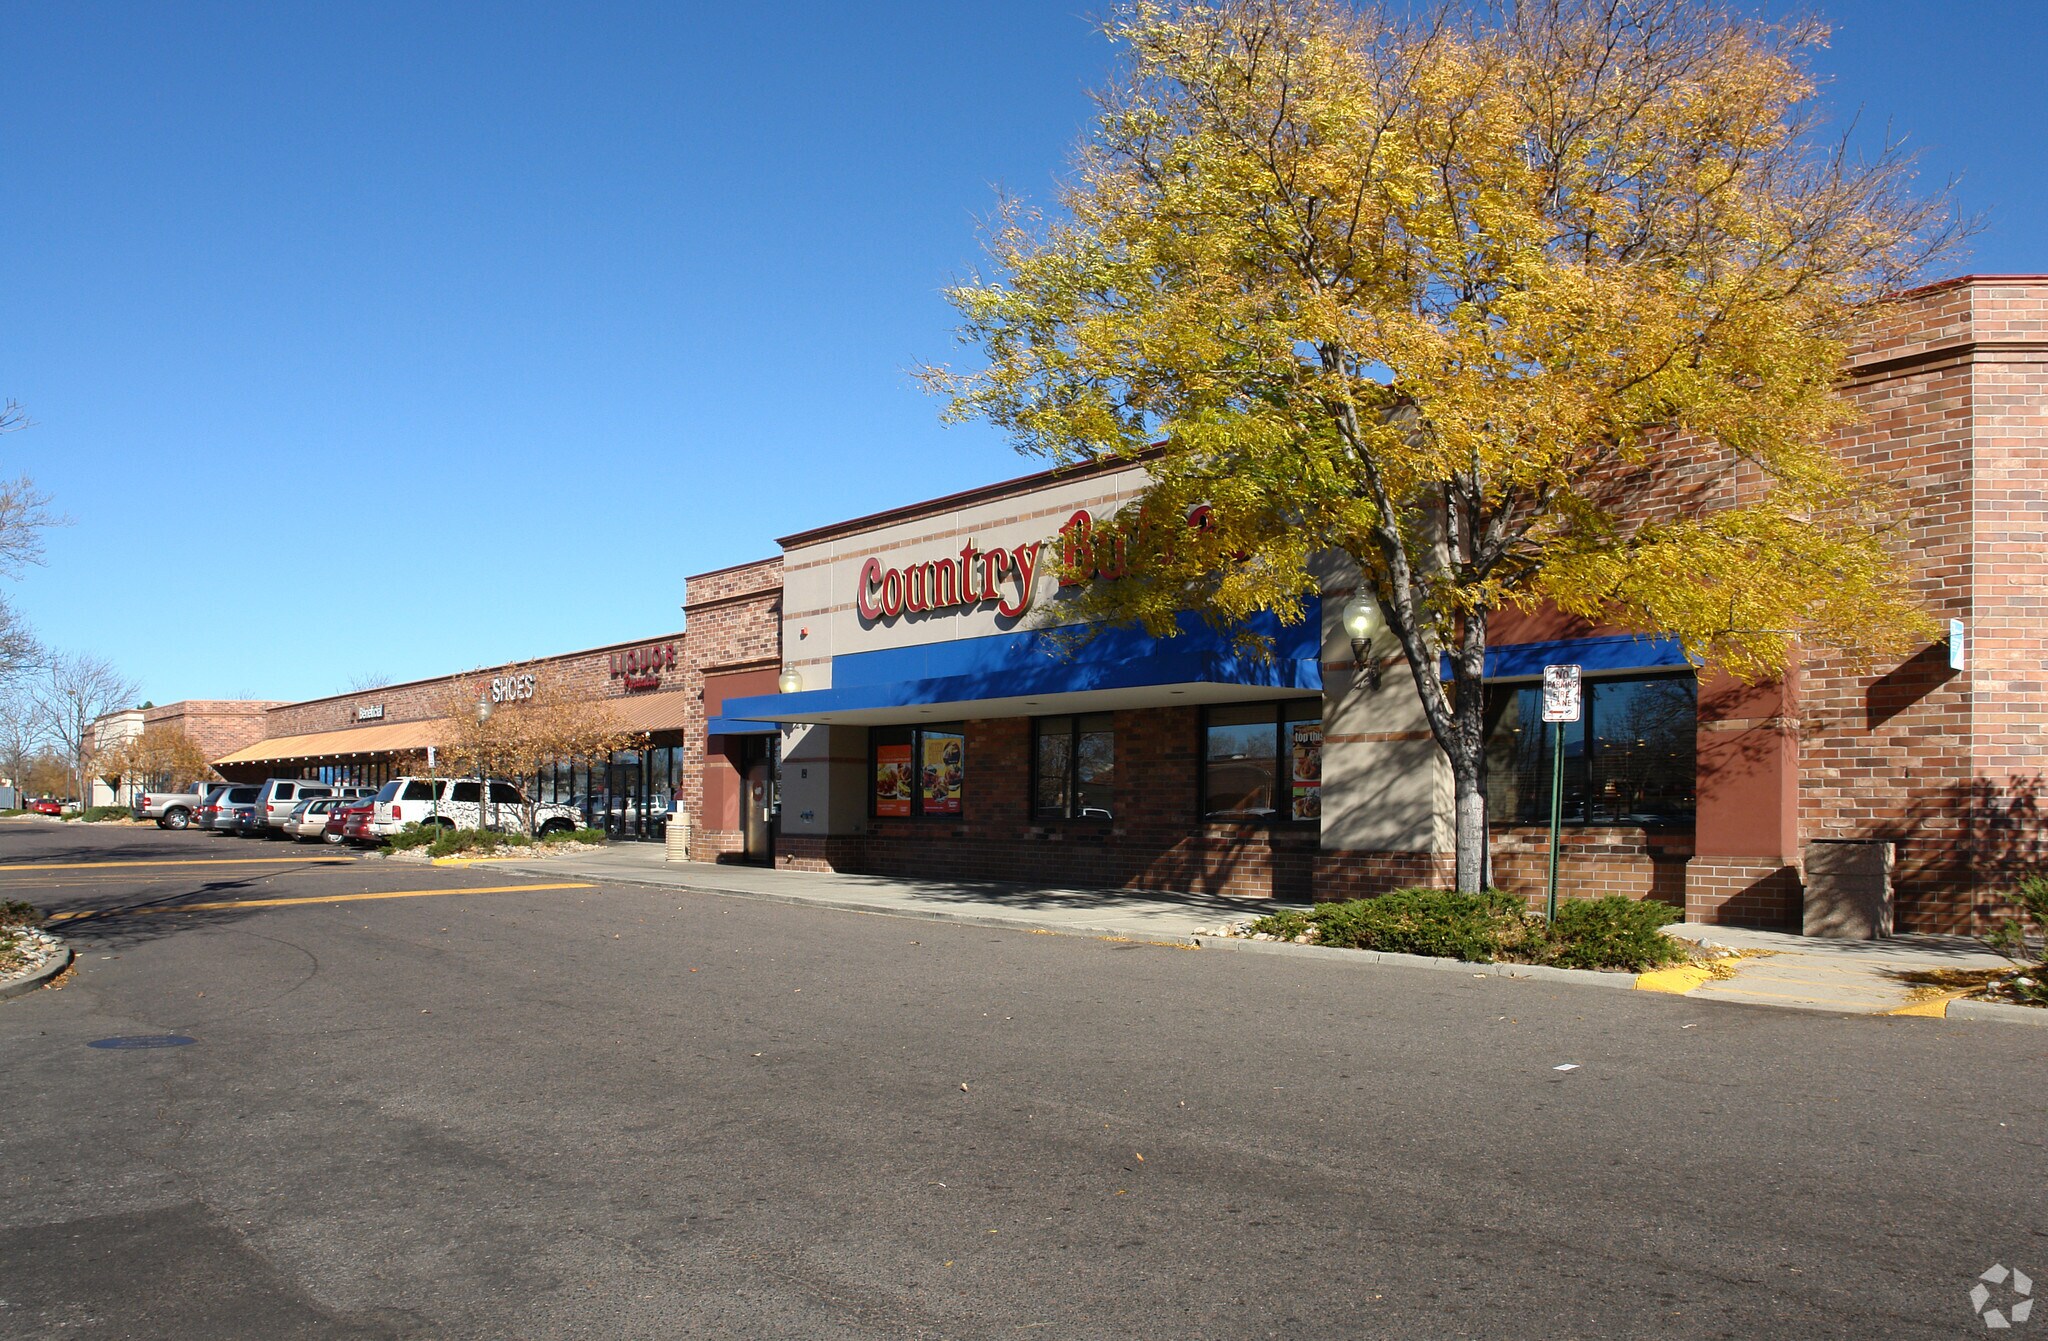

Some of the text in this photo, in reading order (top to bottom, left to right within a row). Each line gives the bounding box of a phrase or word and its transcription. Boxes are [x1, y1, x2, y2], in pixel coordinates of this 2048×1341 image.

[858, 537, 1046, 620] Country
[609, 644, 677, 674] LIQUOR
[1555, 670, 1570, 679] NO
[492, 674, 535, 703] SHOES
[1547, 680, 1578, 689] PARKING
[1552, 690, 1571, 699] FIRE
[1550, 699, 1572, 707] LANE
